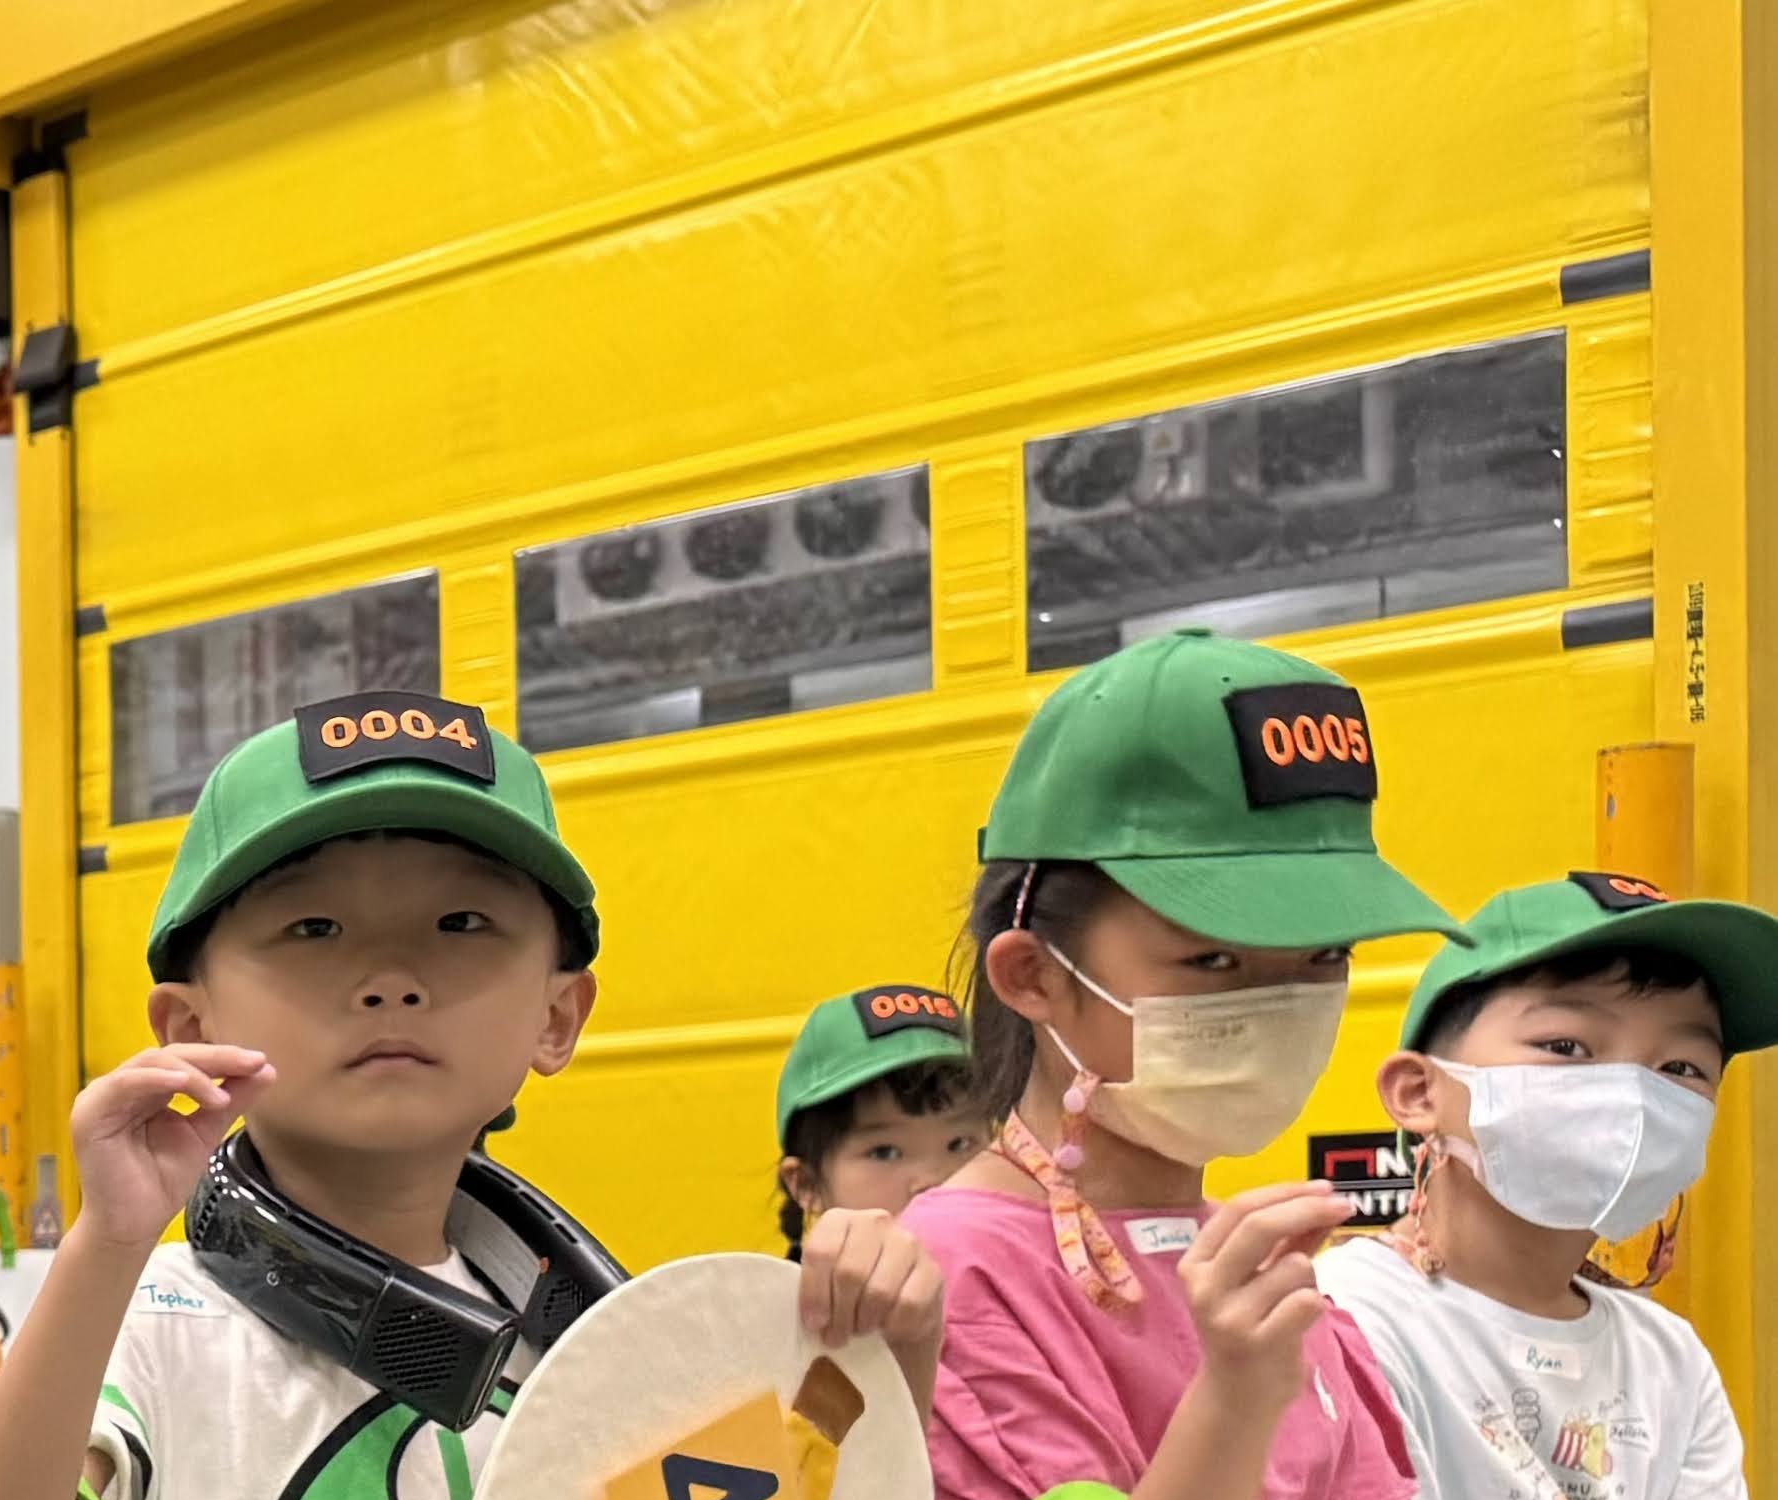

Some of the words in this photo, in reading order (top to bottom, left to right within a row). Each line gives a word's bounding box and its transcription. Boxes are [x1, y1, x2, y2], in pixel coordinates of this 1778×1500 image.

[320, 708, 477, 751] 0004
[1261, 713, 1369, 767] 0005
[1526, 1344, 1563, 1371] Ryan
